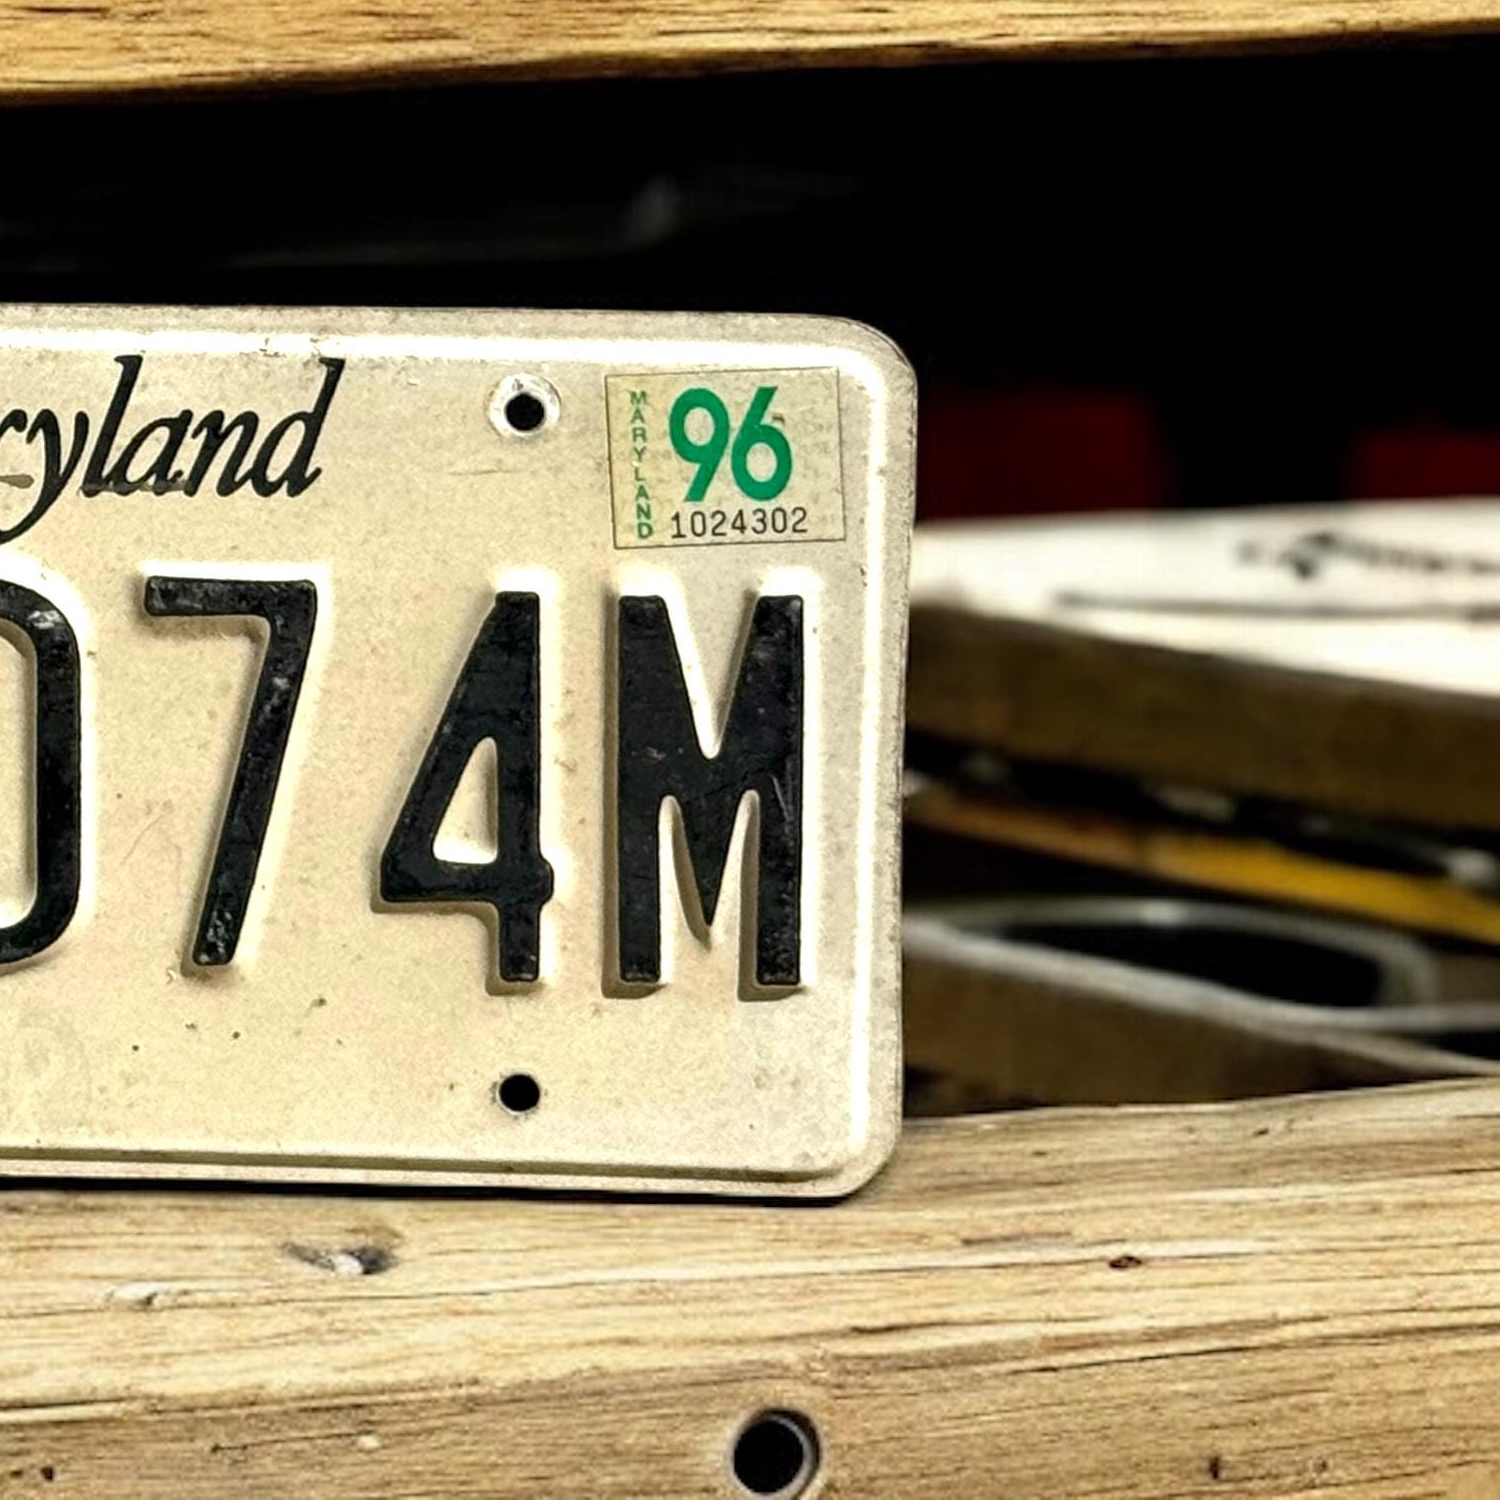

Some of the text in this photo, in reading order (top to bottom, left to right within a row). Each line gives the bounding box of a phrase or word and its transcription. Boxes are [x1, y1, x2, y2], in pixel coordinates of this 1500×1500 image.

[629, 390, 654, 539] MARYLAND
[668, 385, 793, 503] 96
[670, 506, 808, 540] 1024302
